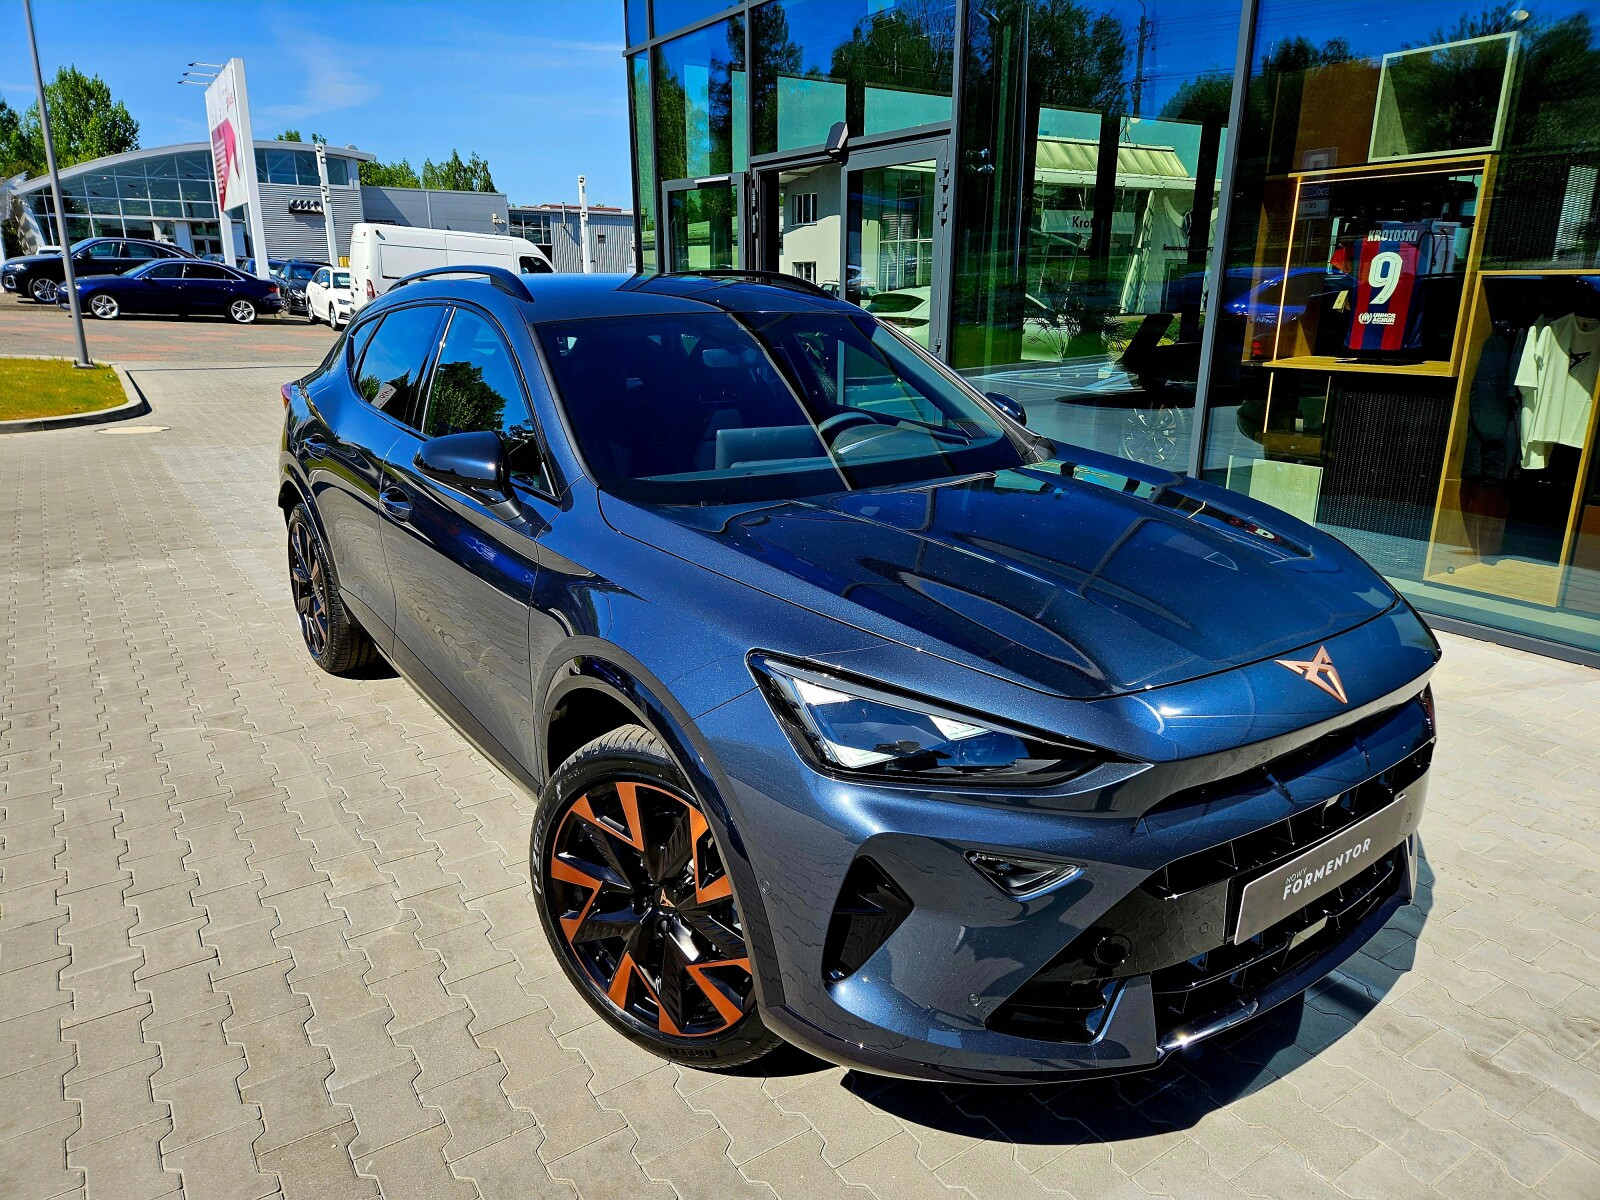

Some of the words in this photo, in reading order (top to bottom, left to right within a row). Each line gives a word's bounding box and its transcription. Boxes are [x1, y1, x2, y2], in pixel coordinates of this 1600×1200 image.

[1367, 229, 1419, 242] KROTOSKI
[1368, 251, 1403, 305] 9
[1283, 838, 1370, 900] FORMENTOR
[1286, 867, 1307, 884] NOWY
